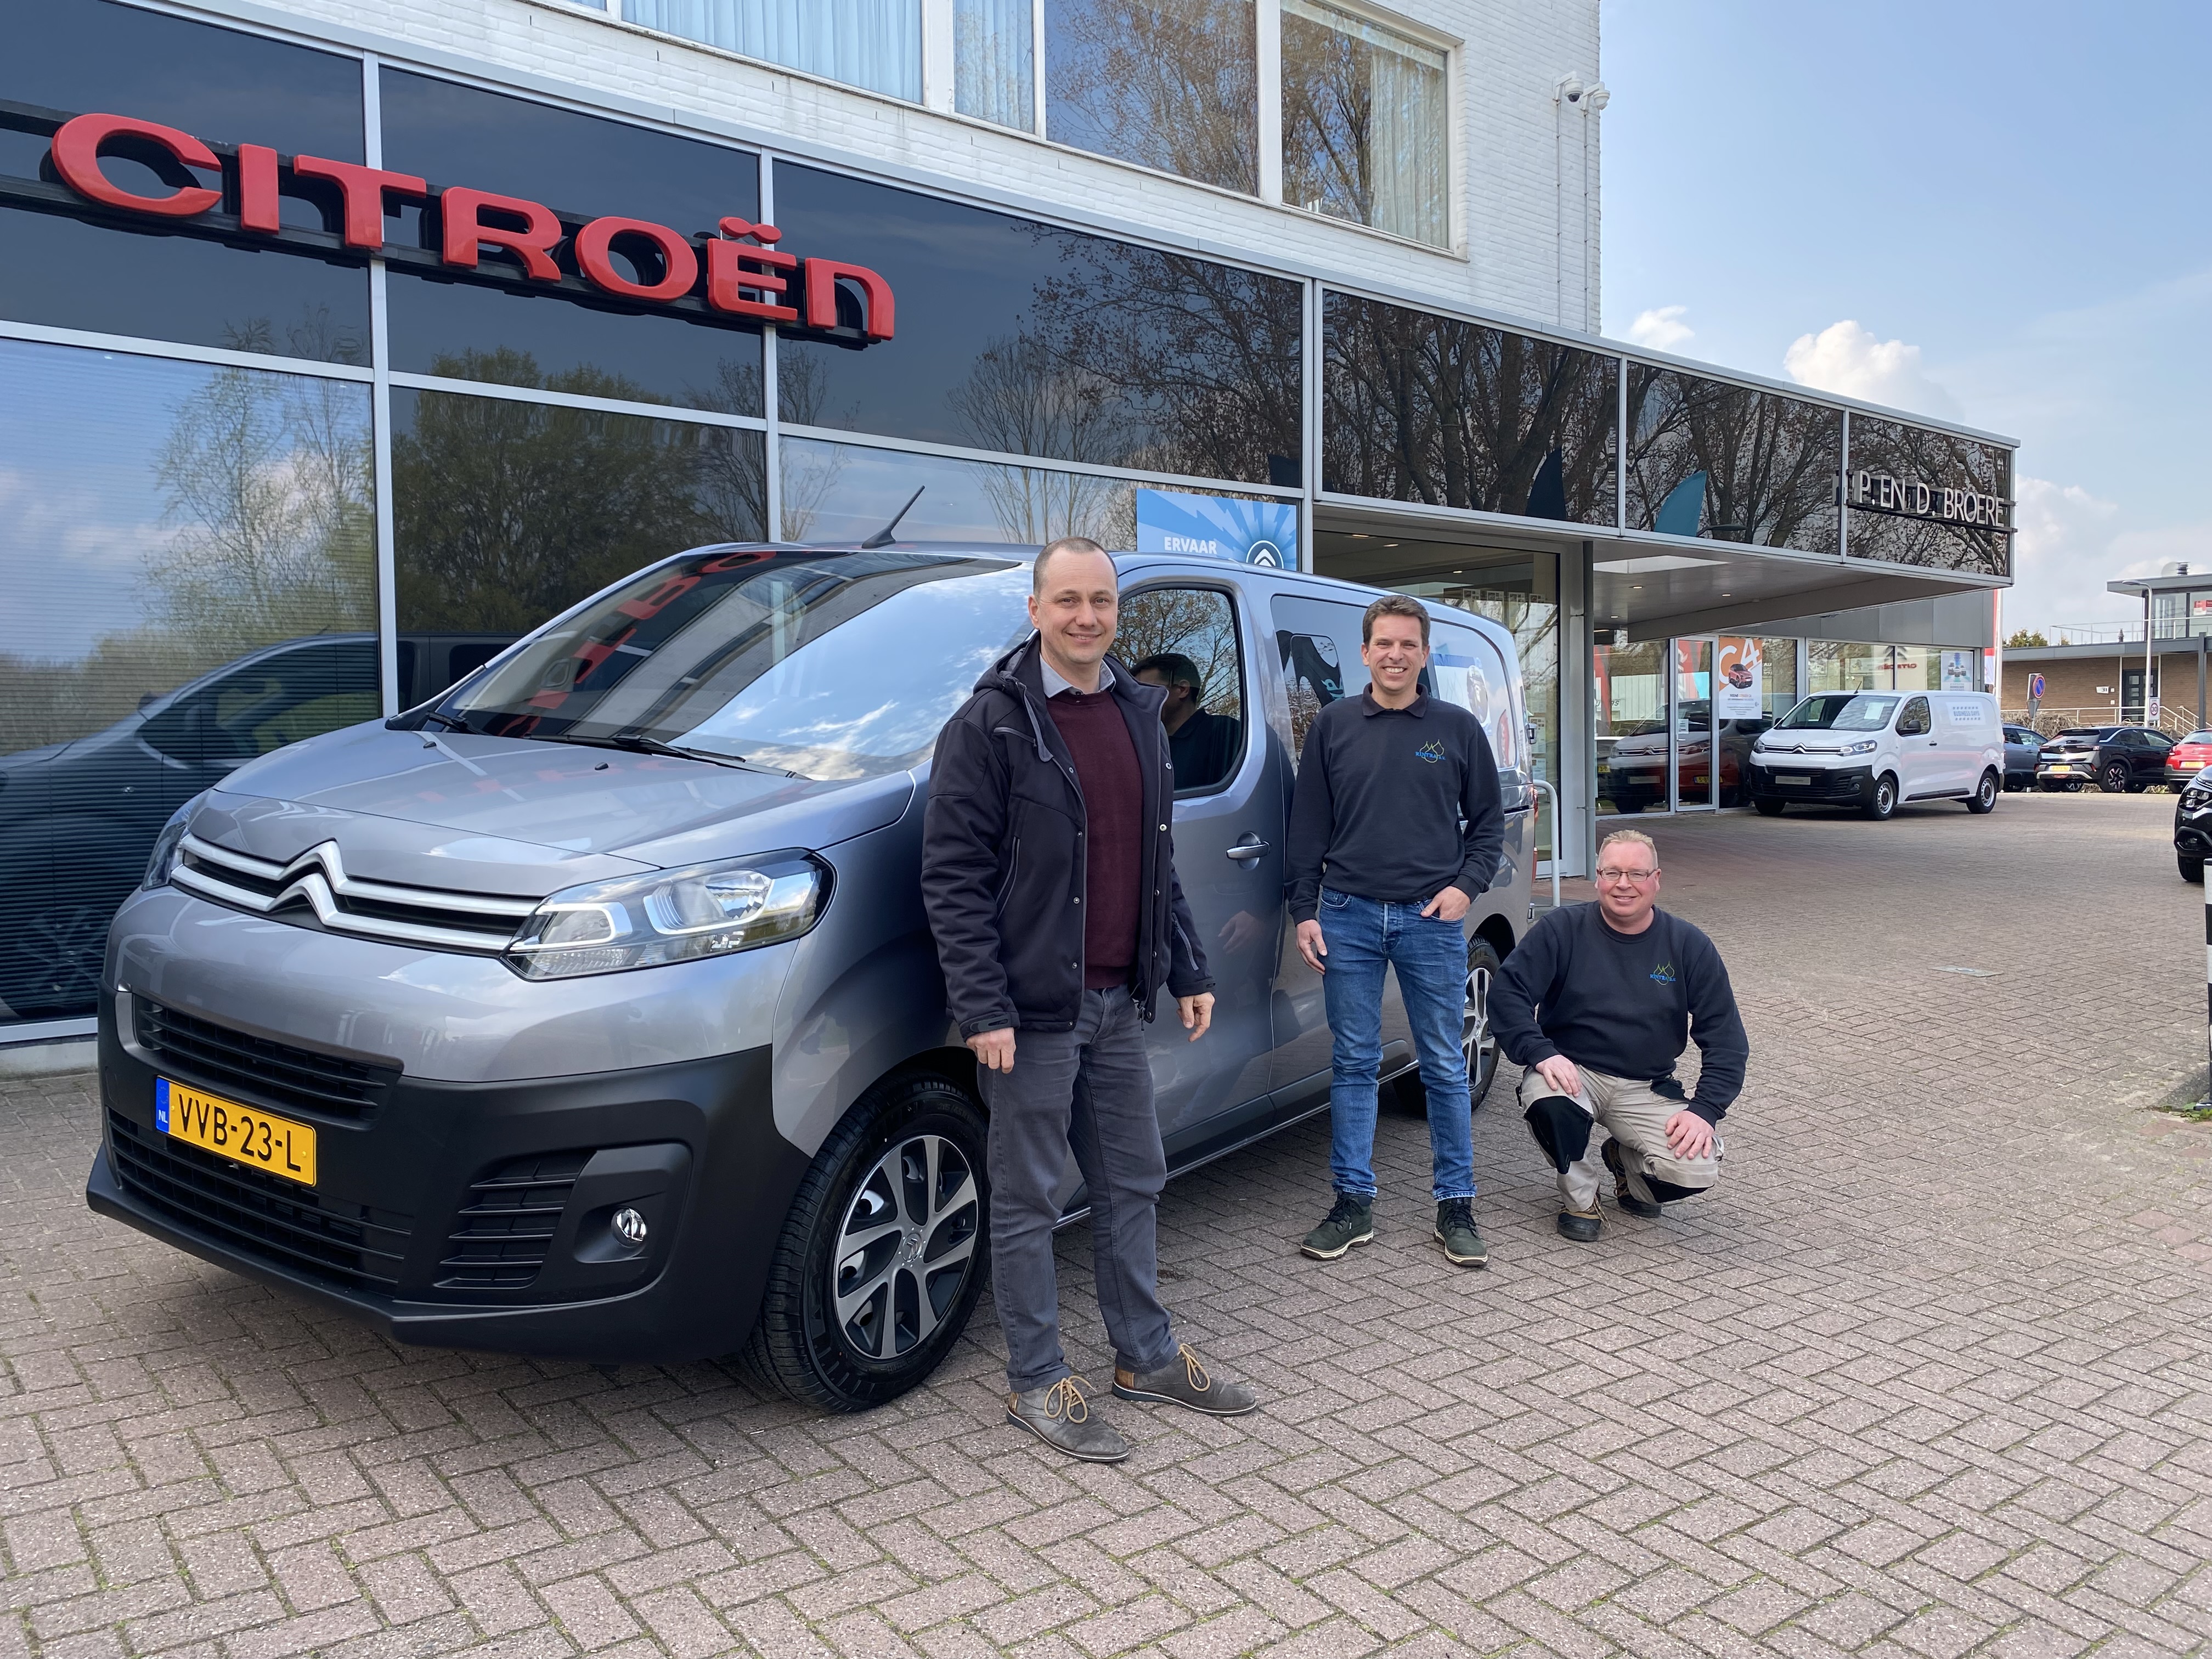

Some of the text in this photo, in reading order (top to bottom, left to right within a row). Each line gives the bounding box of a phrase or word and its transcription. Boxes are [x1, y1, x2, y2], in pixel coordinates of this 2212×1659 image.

[1880, 475, 1906, 511] EN
[1944, 487, 2005, 527] BROERE
[1164, 536, 1217, 555] ERVAAR
[158, 1109, 168, 1124] NL
[178, 1093, 301, 1172] VVB-23-L
